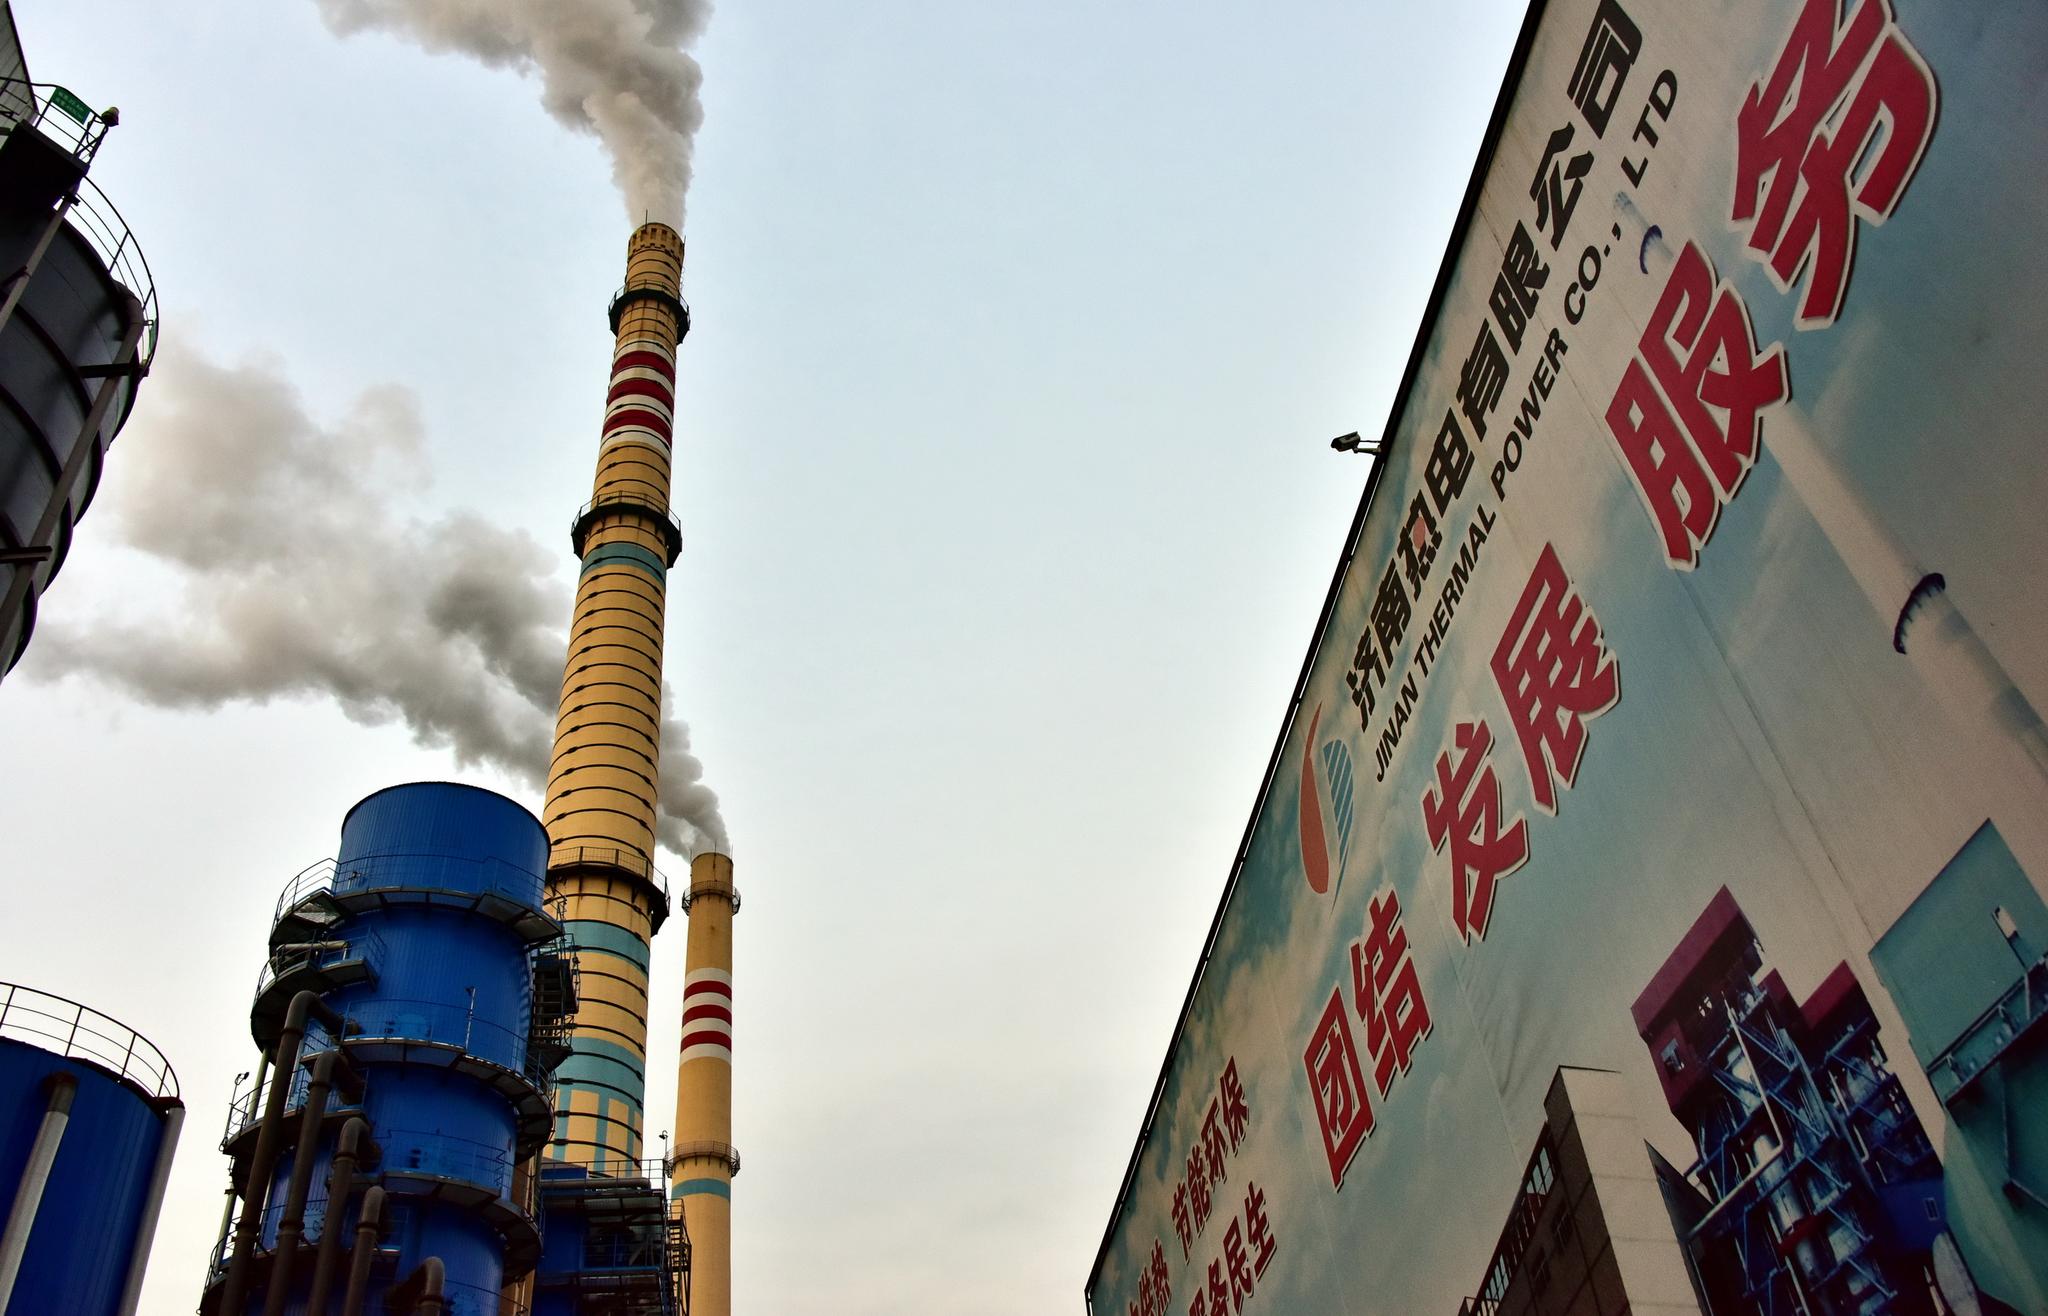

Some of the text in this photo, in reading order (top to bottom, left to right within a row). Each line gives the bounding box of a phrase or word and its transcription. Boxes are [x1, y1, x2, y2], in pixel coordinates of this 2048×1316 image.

[1346, 1, 1643, 732] 济南热电有限公司
[1376, 69, 1679, 782] JINAN THERMAL POWER CO., LTD
[1129, 1055, 1249, 1316] 供热 节能环保
[1188, 1180, 1276, 1316] 务民生
